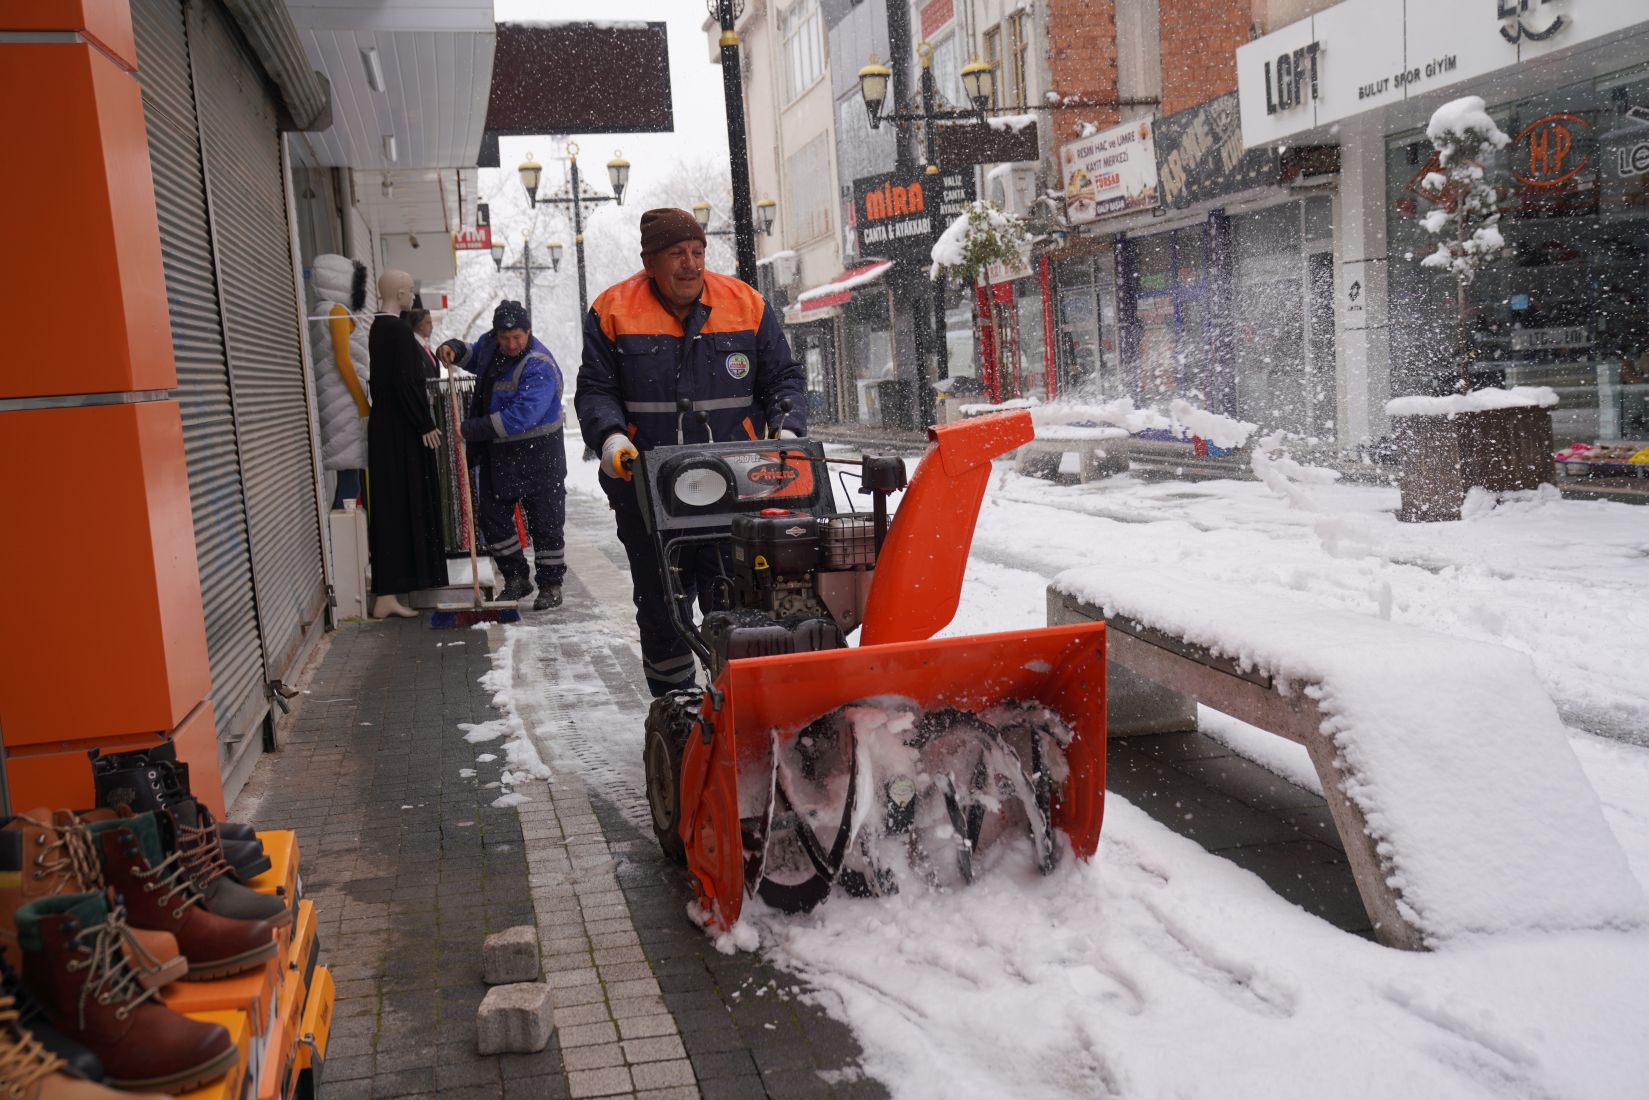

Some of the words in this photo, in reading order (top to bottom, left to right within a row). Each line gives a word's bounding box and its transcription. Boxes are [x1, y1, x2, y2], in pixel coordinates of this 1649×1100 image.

[1358, 78, 1389, 101] BULUT
[1393, 67, 1421, 89] SPOR
[1425, 54, 1457, 78] GİYİM
[888, 224, 895, 241] &
